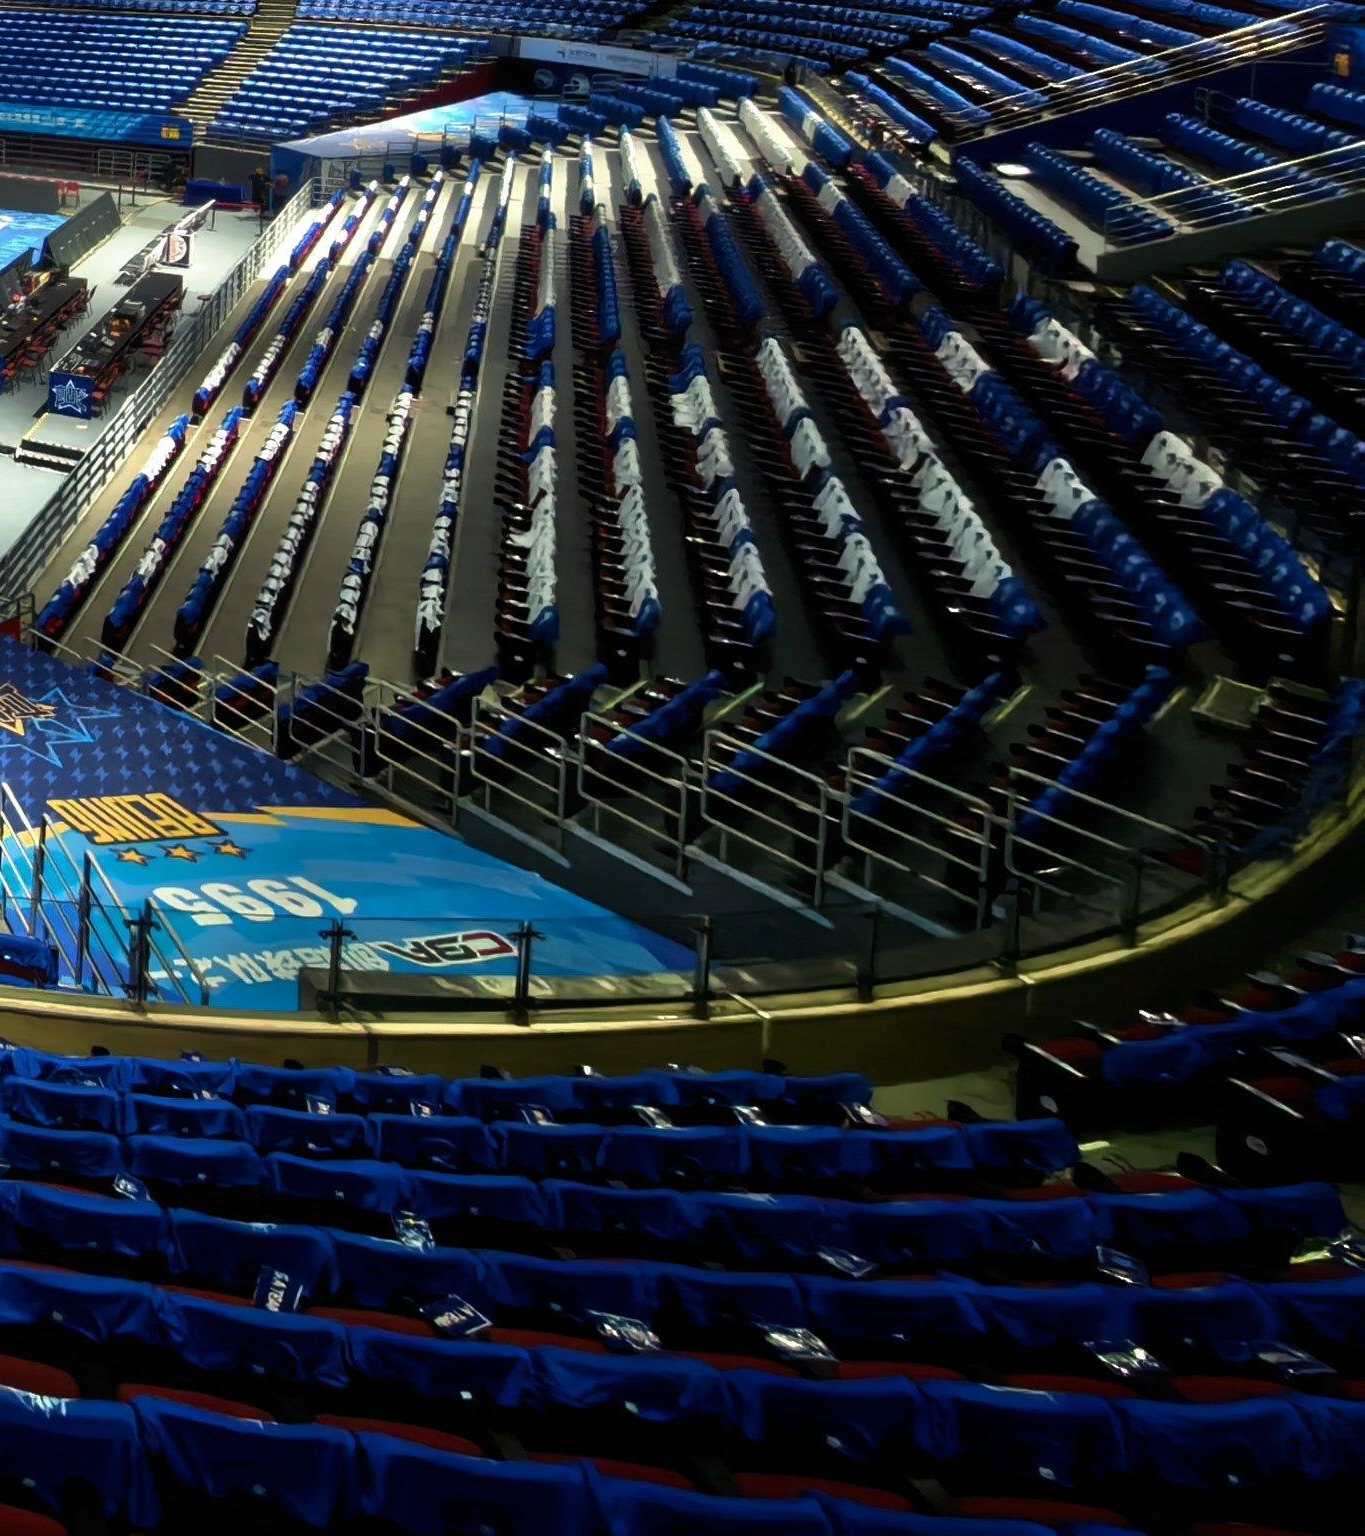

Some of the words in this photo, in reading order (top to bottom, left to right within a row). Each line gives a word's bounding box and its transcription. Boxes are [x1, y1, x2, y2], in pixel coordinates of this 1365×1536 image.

[49, 792, 223, 844] BEIJING
[151, 874, 359, 927] 1995
[379, 932, 519, 964] CBA
